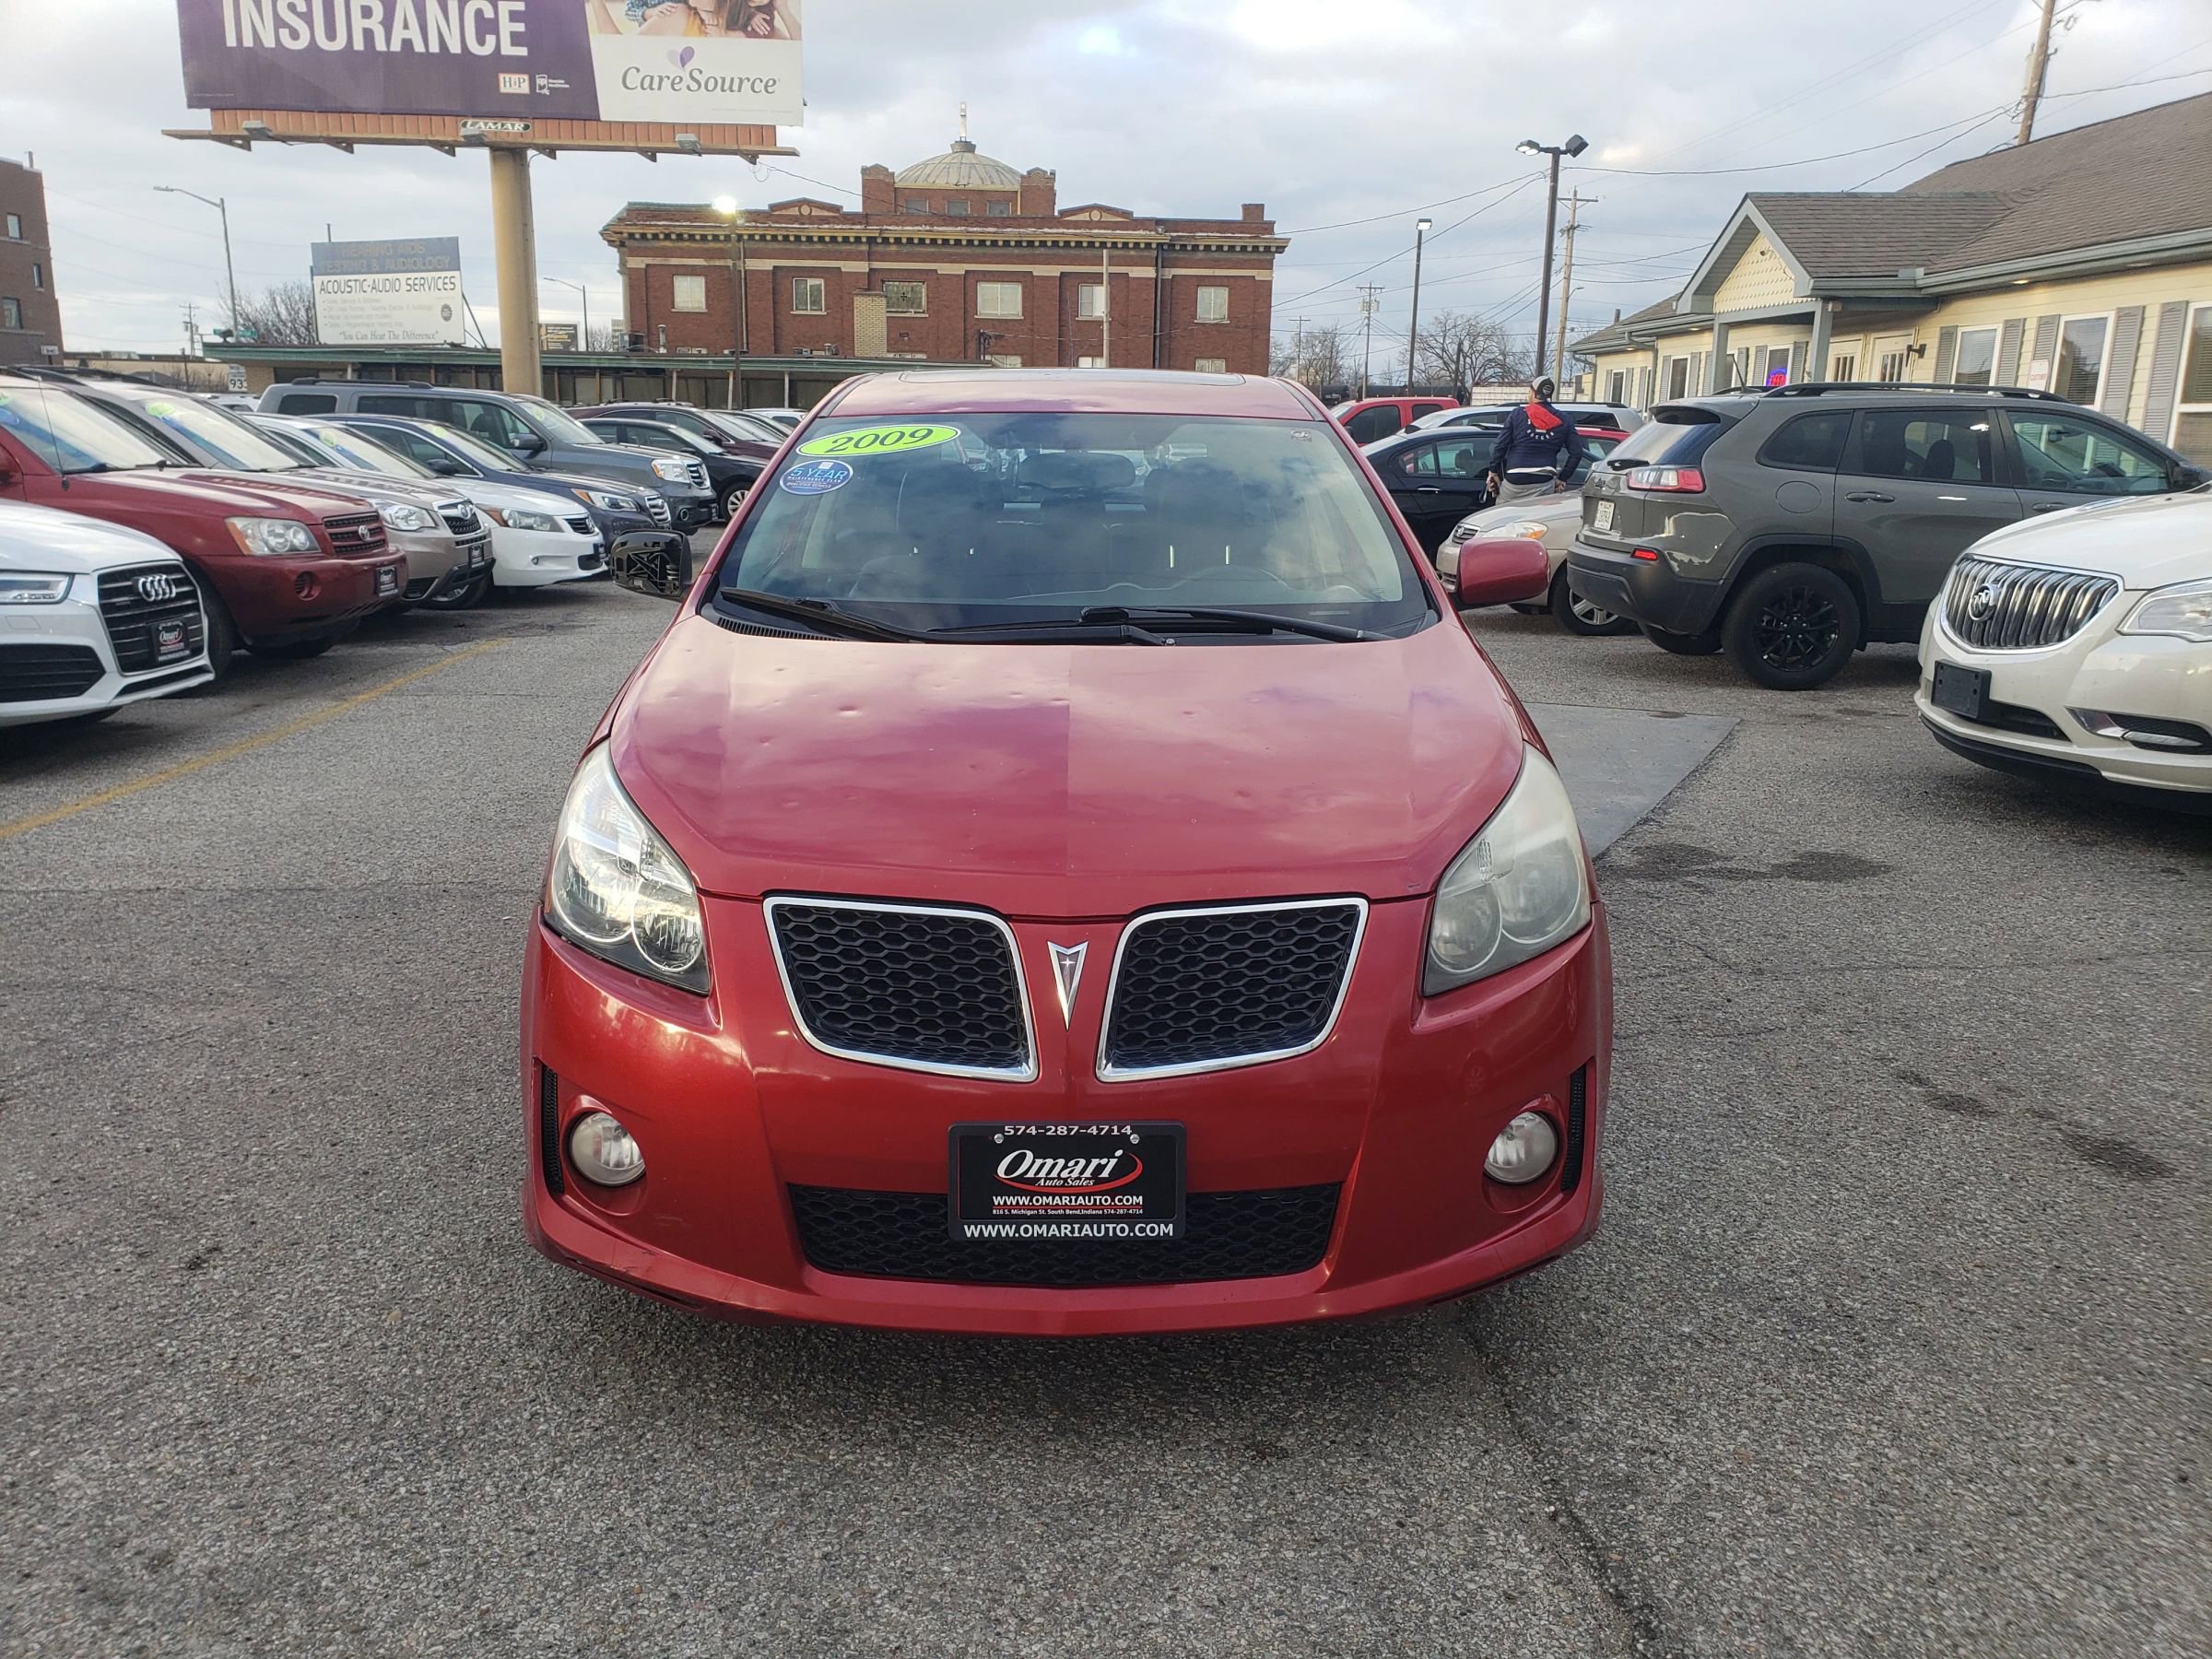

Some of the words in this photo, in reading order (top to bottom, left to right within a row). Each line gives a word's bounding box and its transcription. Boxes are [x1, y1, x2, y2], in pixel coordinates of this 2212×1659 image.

[222, 0, 529, 56] INSURANCE
[621, 65, 777, 94] CareSource
[465, 121, 524, 131] LAMAR
[385, 255, 451, 270] AUDIOLOGY
[405, 276, 456, 292] SERVICES
[824, 428, 934, 453] 2009
[790, 467, 805, 477] 5
[806, 468, 848, 479] YEAR
[1004, 1125, 1133, 1135] 574-287-4714
[996, 1149, 1124, 1179] Omari
[1035, 1178, 1063, 1186] Auto
[1065, 1177, 1095, 1186] Sales
[993, 1195, 1143, 1206] WWW.OMARIAUTO.COM
[964, 1224, 1173, 1237] WWW.OMARIAUTO.COM
